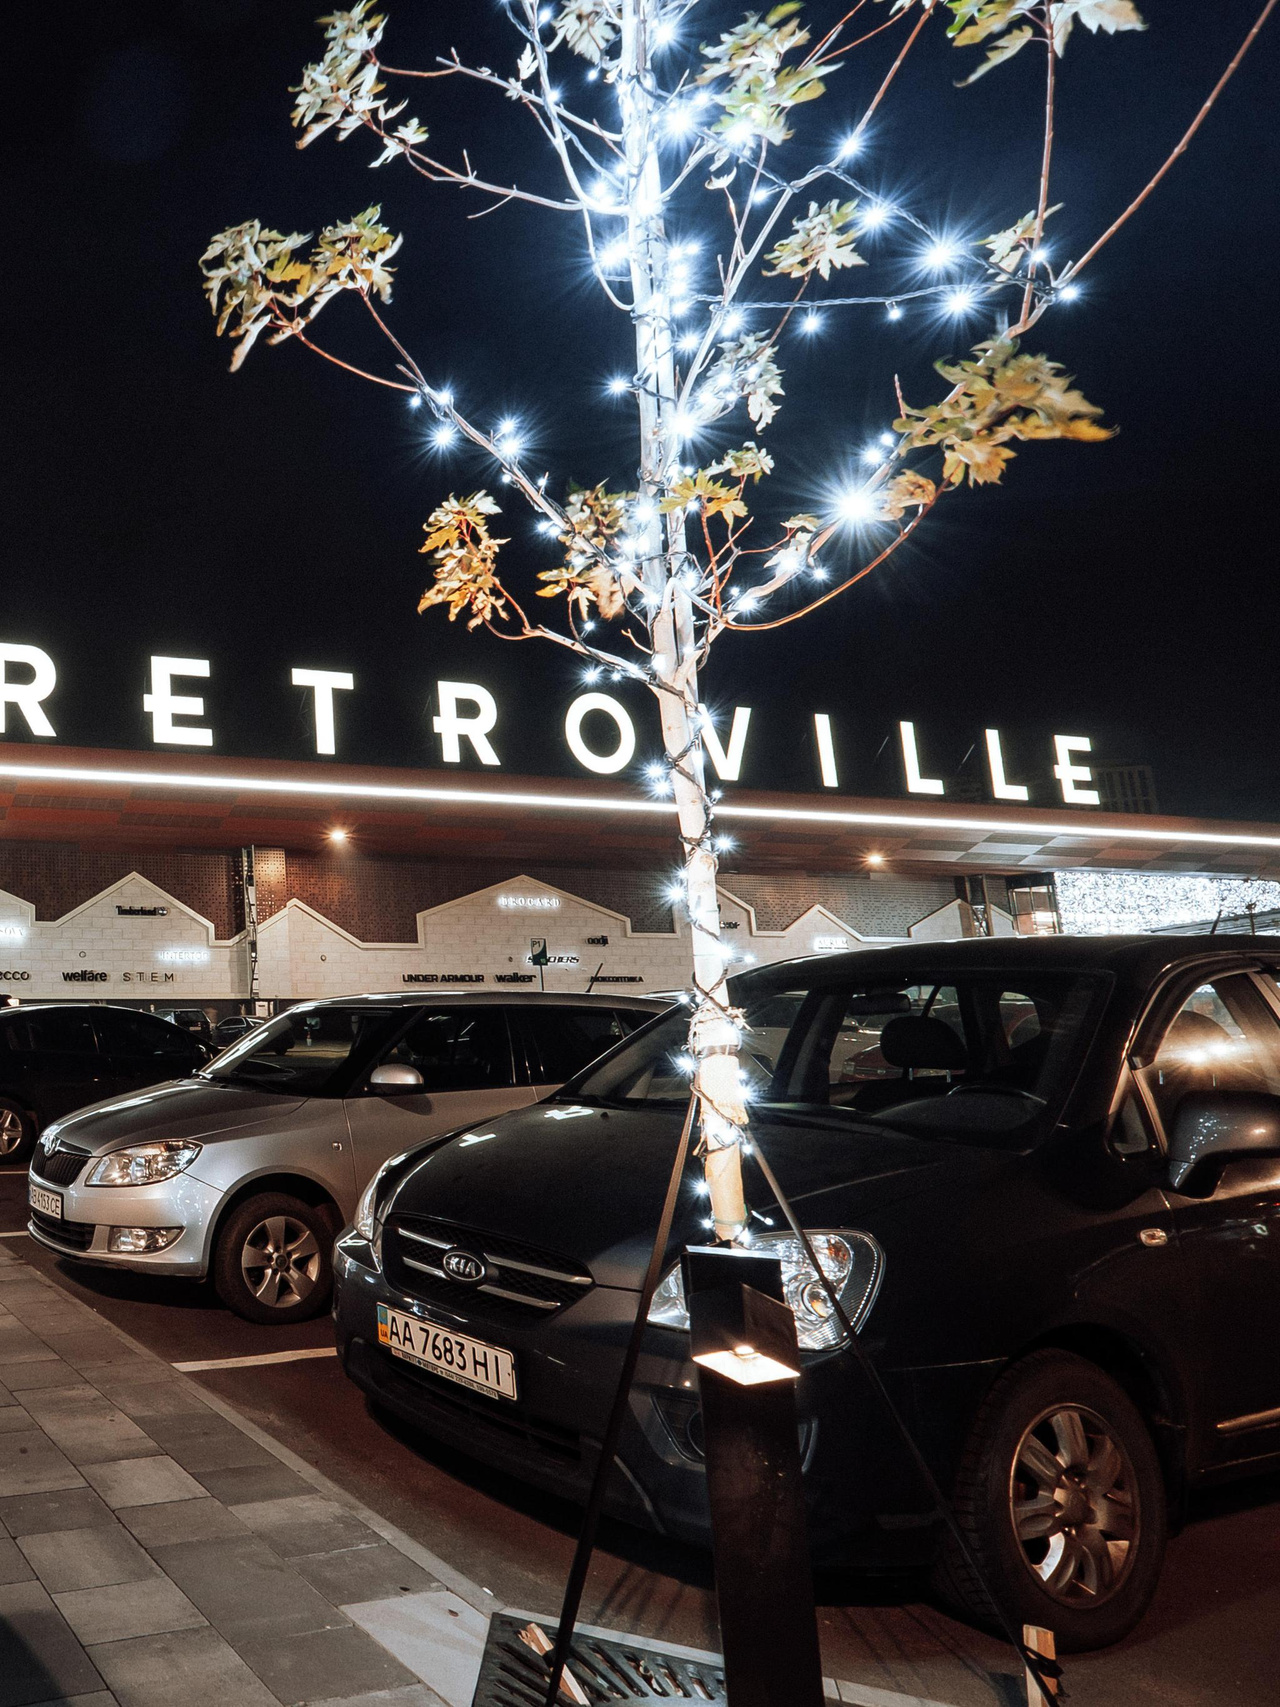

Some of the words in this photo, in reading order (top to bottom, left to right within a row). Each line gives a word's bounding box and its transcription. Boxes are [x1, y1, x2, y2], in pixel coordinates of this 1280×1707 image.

[532, 940, 541, 948] P1
[62, 970, 108, 982] welfare
[122, 972, 174, 982] STEM
[402, 974, 439, 983] UNDER
[440, 974, 485, 983] ARMOUR
[495, 972, 537, 983] walker
[449, 1256, 477, 1278] KIA
[380, 1329, 389, 1338] UA
[389, 1315, 415, 1351] AA
[419, 1326, 467, 1371] 7683
[472, 1346, 501, 1387] HI
